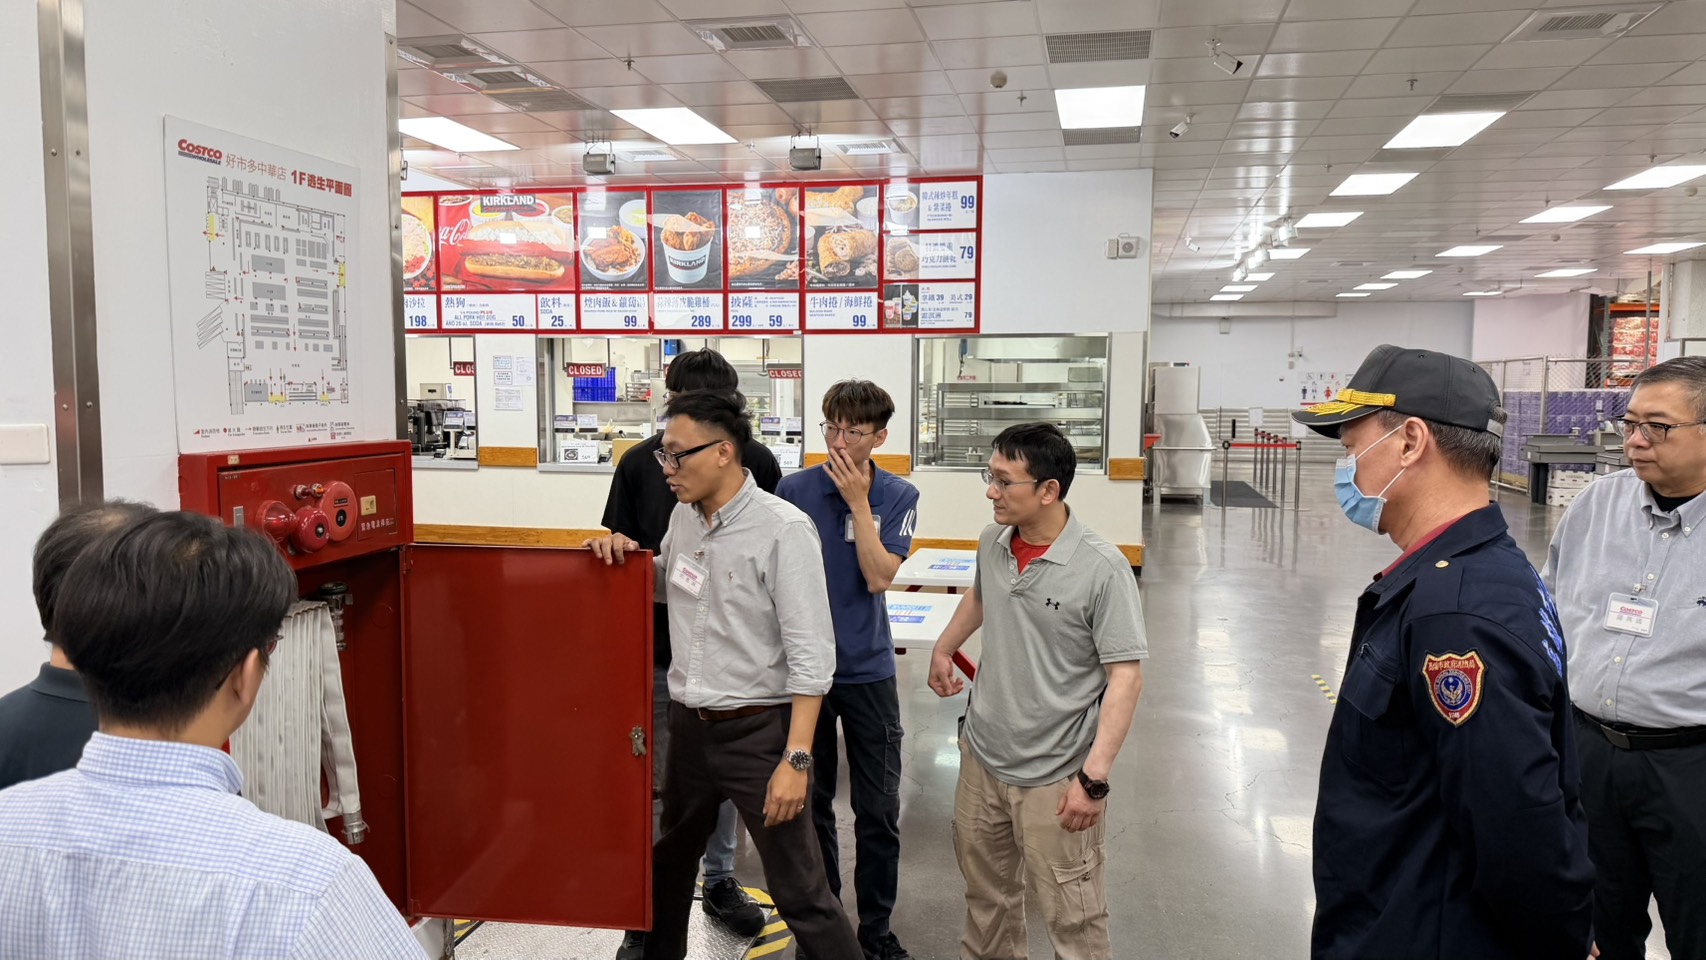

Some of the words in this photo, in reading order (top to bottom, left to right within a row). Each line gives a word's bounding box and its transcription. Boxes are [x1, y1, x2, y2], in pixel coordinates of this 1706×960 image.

[178, 139, 223, 160] COSTCO
[191, 154, 222, 166] WHOLESALE
[225, 152, 288, 182] 好市多中華店
[482, 195, 535, 207] KIRKLAND
[960, 195, 976, 210] 99
[959, 245, 975, 260] 79
[445, 296, 466, 309] 熱狗
[540, 297, 562, 309] 飲料
[731, 296, 754, 309] 披薩
[964, 293, 973, 301] 29
[409, 315, 428, 328] 198
[512, 315, 526, 328] 50
[551, 315, 564, 328] 25
[624, 315, 638, 328] 99
[691, 315, 711, 328] 289
[731, 315, 752, 328] 299
[769, 315, 783, 328] 59
[852, 314, 867, 328] 99
[964, 311, 973, 319] 79
[568, 365, 602, 375] CLOSED
